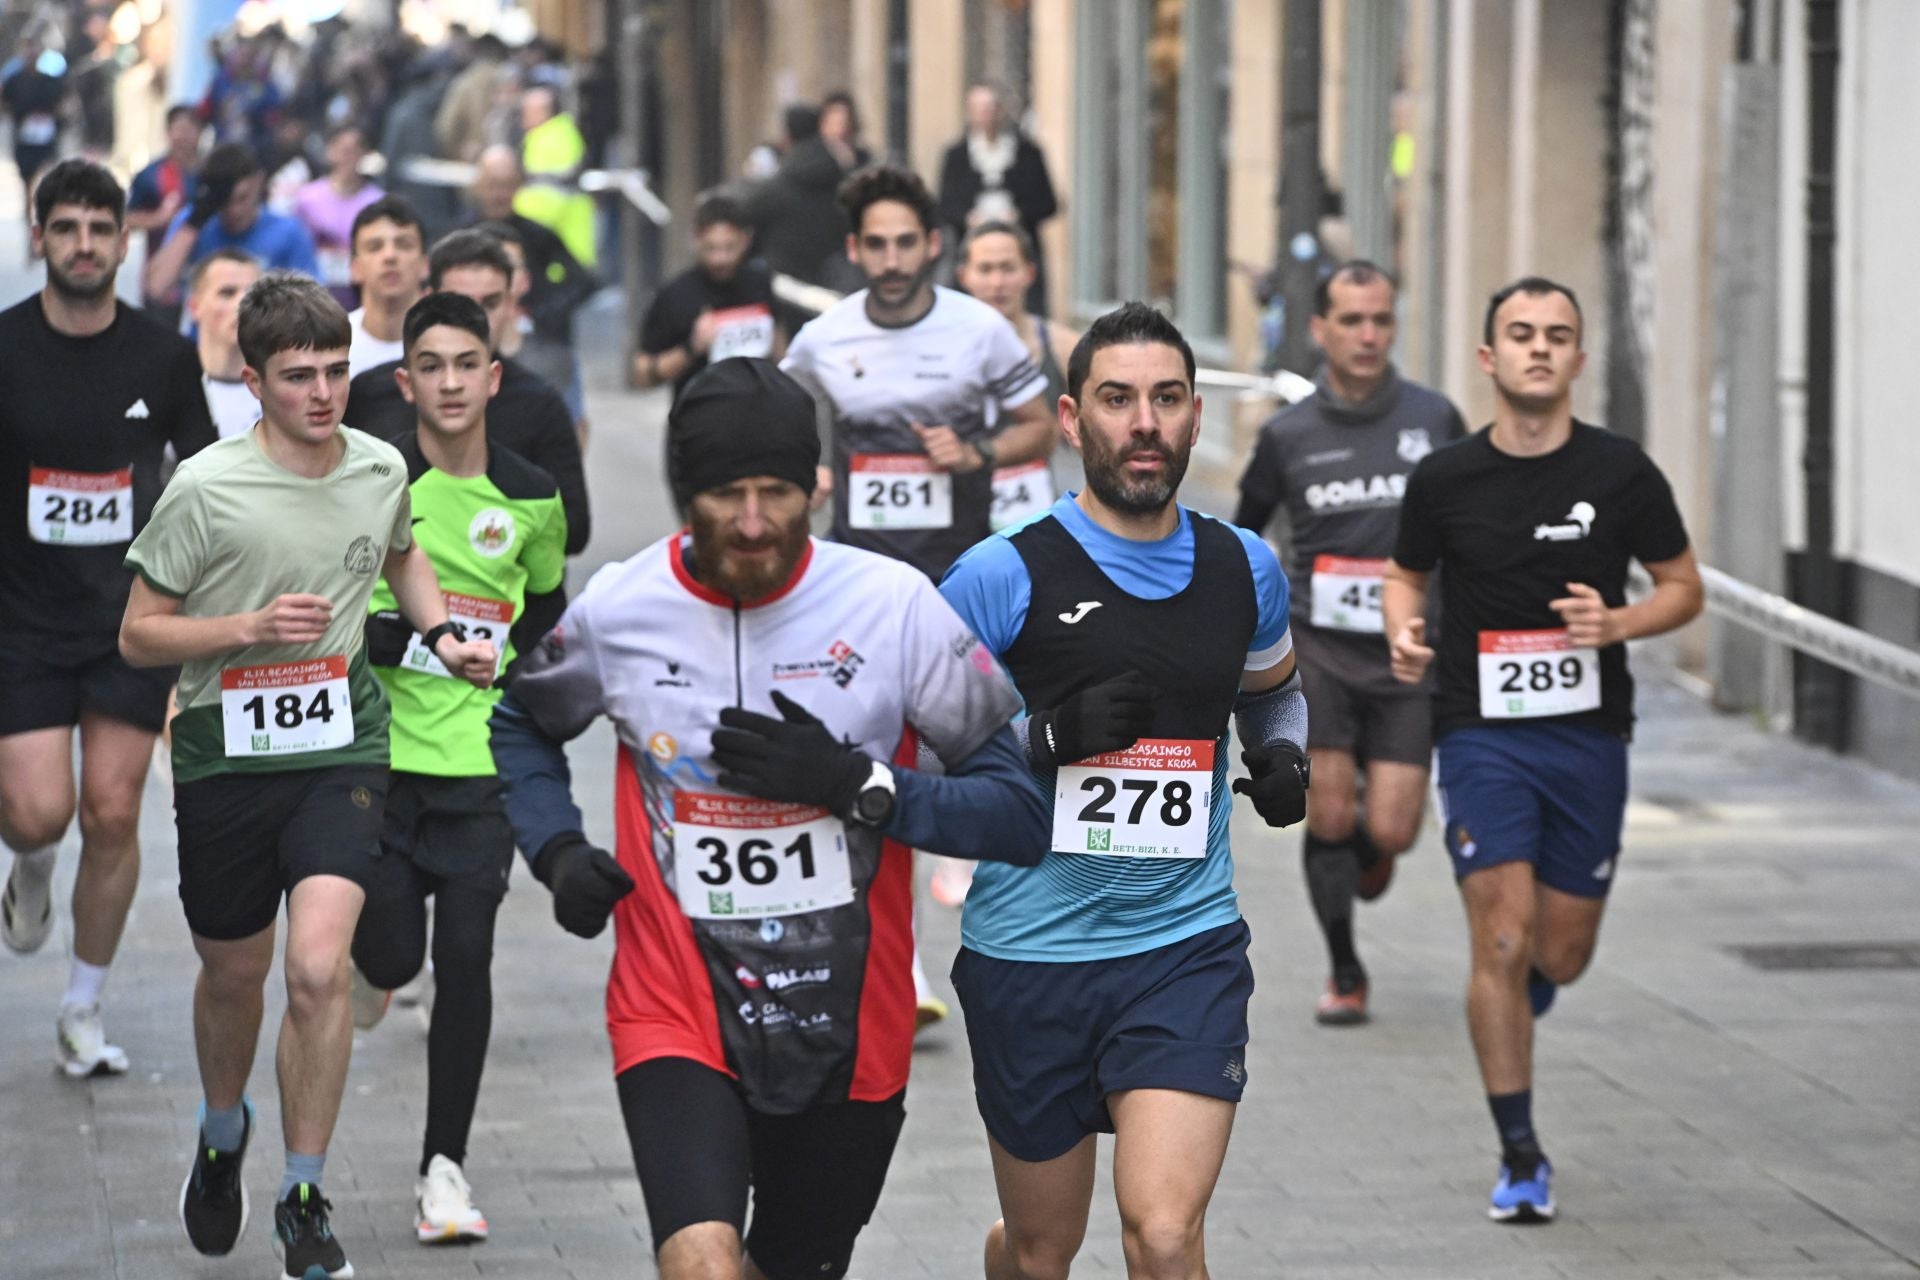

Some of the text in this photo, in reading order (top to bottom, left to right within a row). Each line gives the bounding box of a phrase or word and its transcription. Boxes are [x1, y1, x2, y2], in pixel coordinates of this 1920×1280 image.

[44, 495, 120, 526] 284
[867, 480, 933, 508] 261
[1499, 657, 1584, 693] 289
[243, 688, 334, 731] 184
[1104, 755, 1164, 768] SILBESTRE
[1167, 758, 1197, 768] KROSA
[1077, 776, 1192, 827] 278
[696, 831, 815, 886] 361
